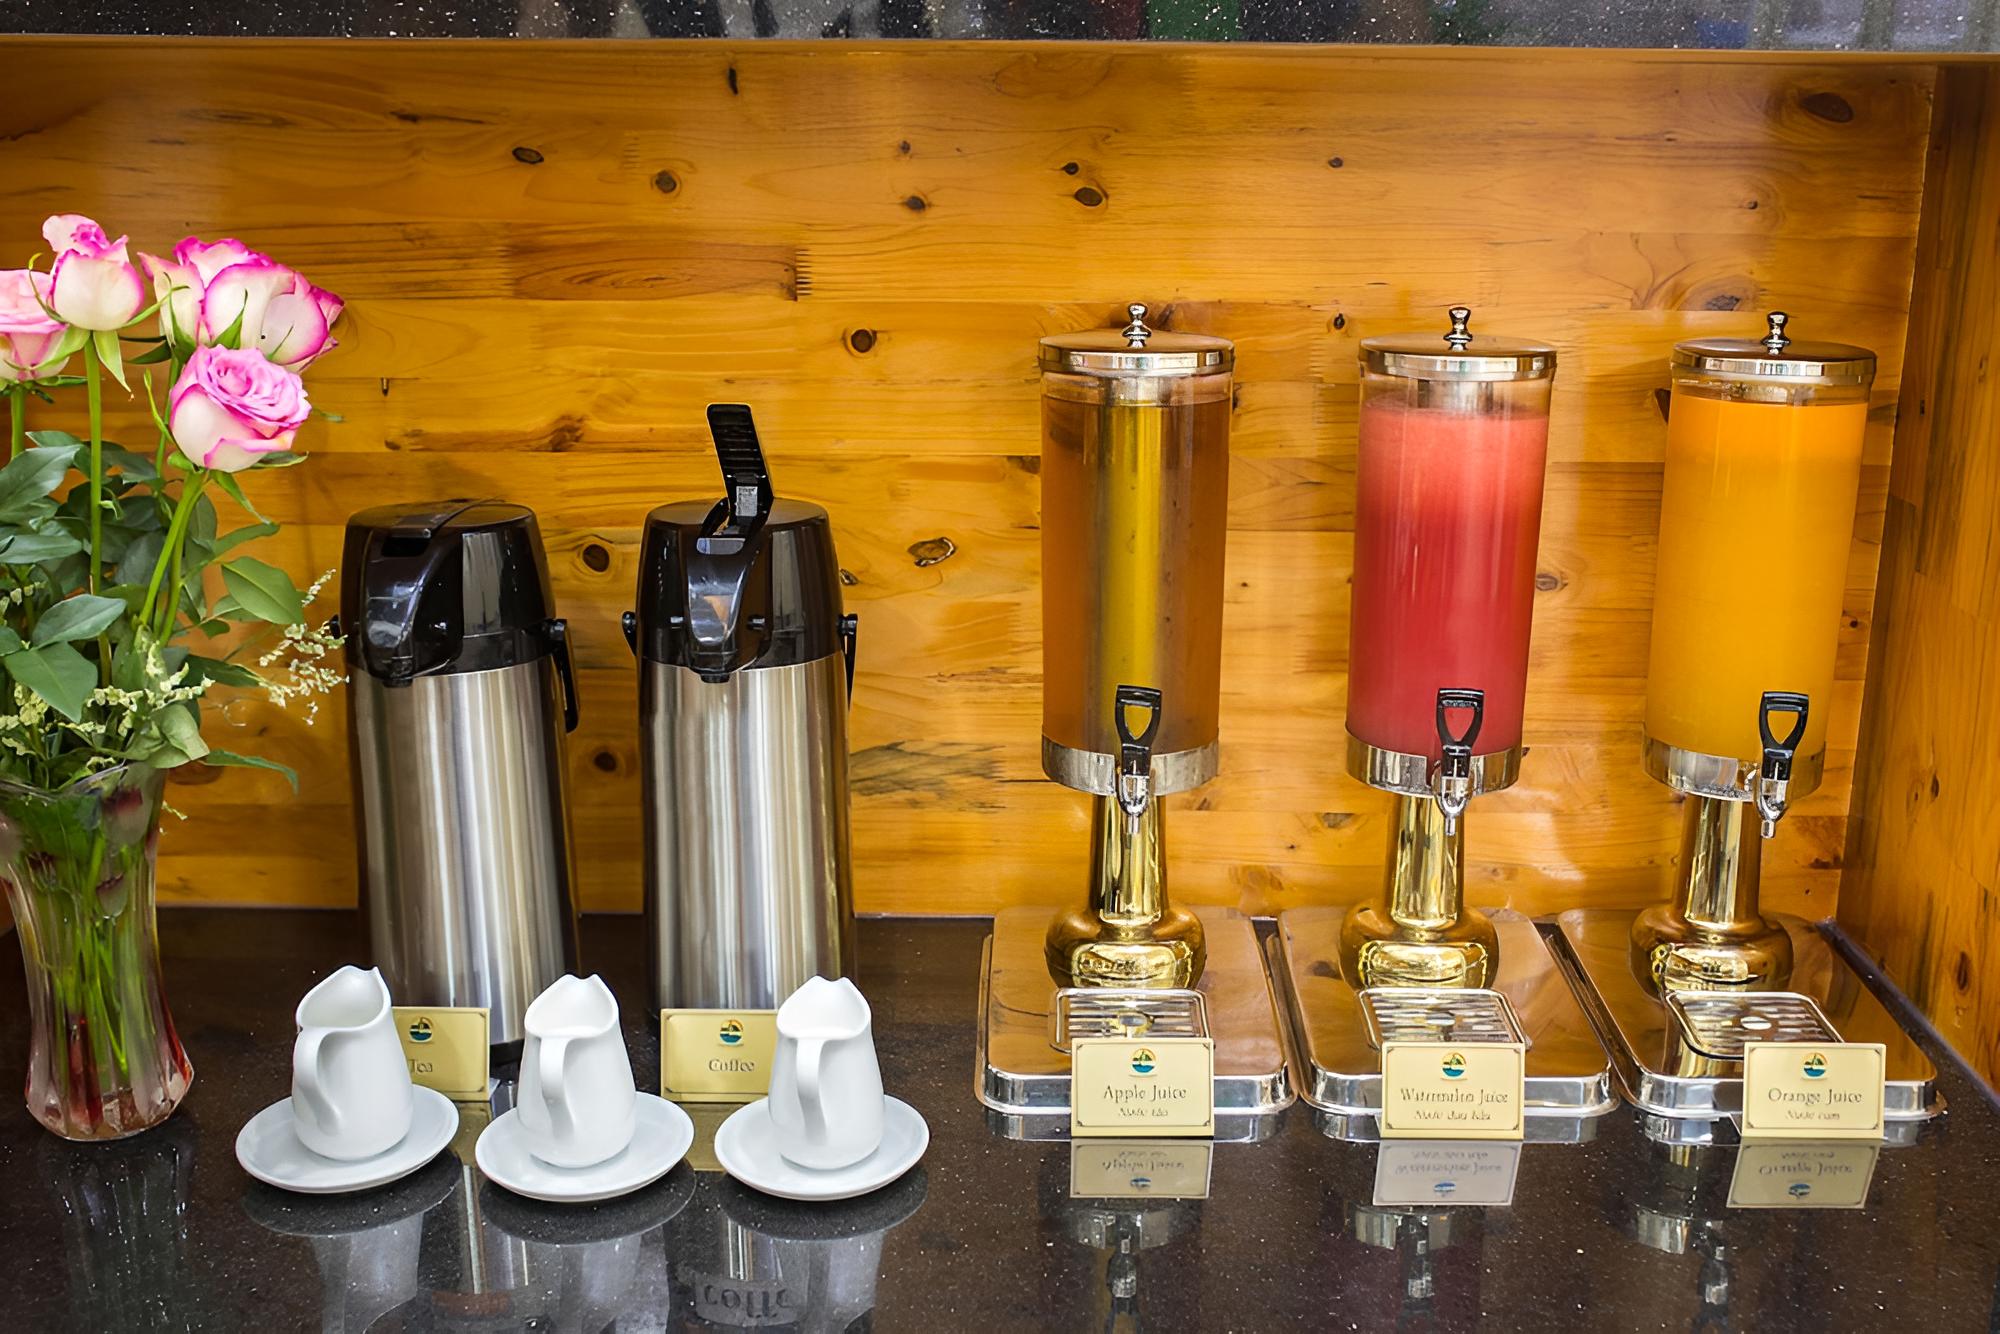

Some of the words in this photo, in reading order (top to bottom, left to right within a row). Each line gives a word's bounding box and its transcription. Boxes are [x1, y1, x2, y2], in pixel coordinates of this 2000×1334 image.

[708, 1059, 755, 1072] Coffee
[1103, 1084, 1146, 1104] Apple
[1151, 1084, 1187, 1102] Juice
[1479, 1088, 1509, 1106] Juice
[1768, 1087, 1821, 1106] Orange
[1827, 1088, 1863, 1106] Juice
